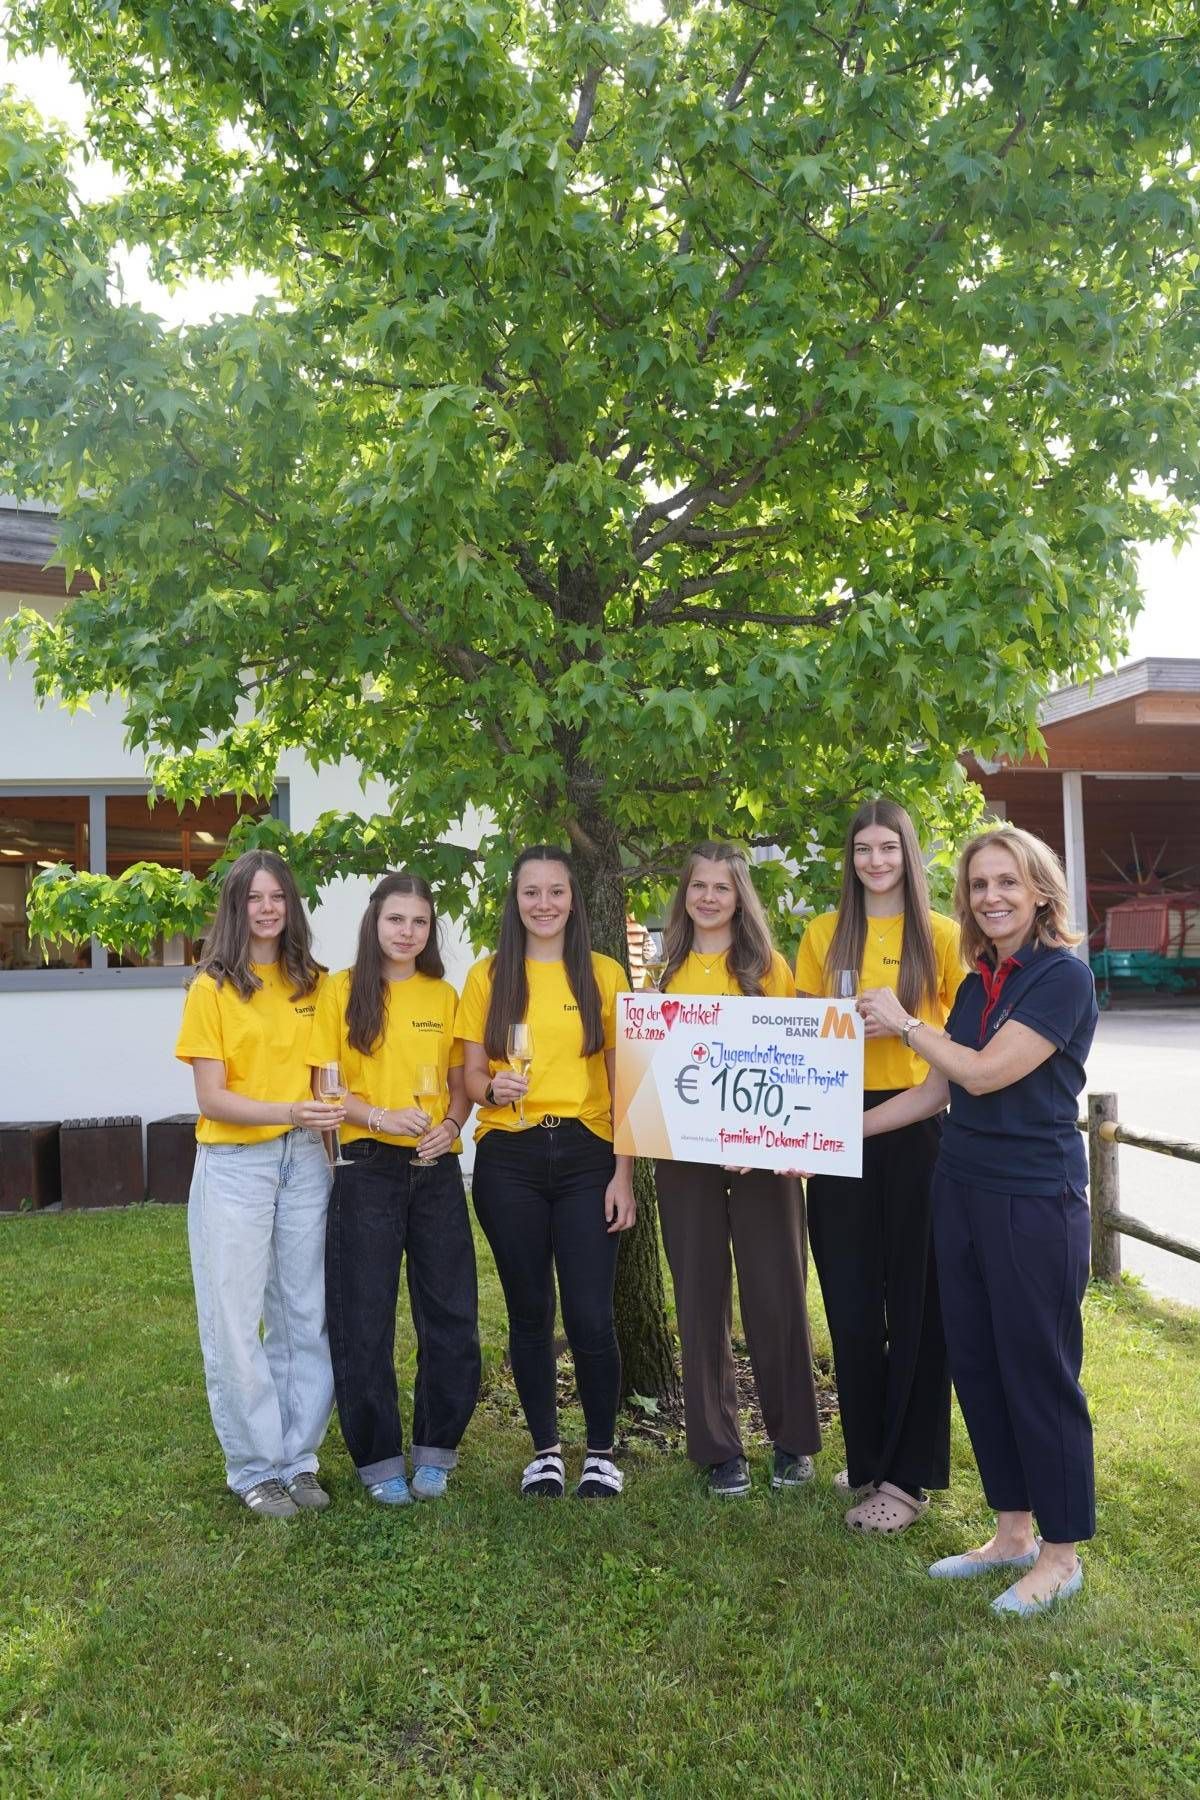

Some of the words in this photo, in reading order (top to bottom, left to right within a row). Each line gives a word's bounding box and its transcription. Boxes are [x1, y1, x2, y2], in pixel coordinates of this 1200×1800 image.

[883, 957, 901, 965] fam
[623, 998, 645, 1028] Tag
[647, 1005, 661, 1020] der
[680, 1002, 724, 1026] lichkeit
[752, 1015, 819, 1027] DOLOMITEN
[624, 1027, 666, 1041] 12.6.2026
[785, 1027, 819, 1038] BANK
[710, 1042, 806, 1070] Jugendrotkreuz
[674, 1065, 700, 1105] €
[769, 1066, 806, 1085] Schüler
[807, 1067, 849, 1094] Projekt
[765, 1130, 811, 1149] Dekanat
[813, 1132, 846, 1153] Lienz
